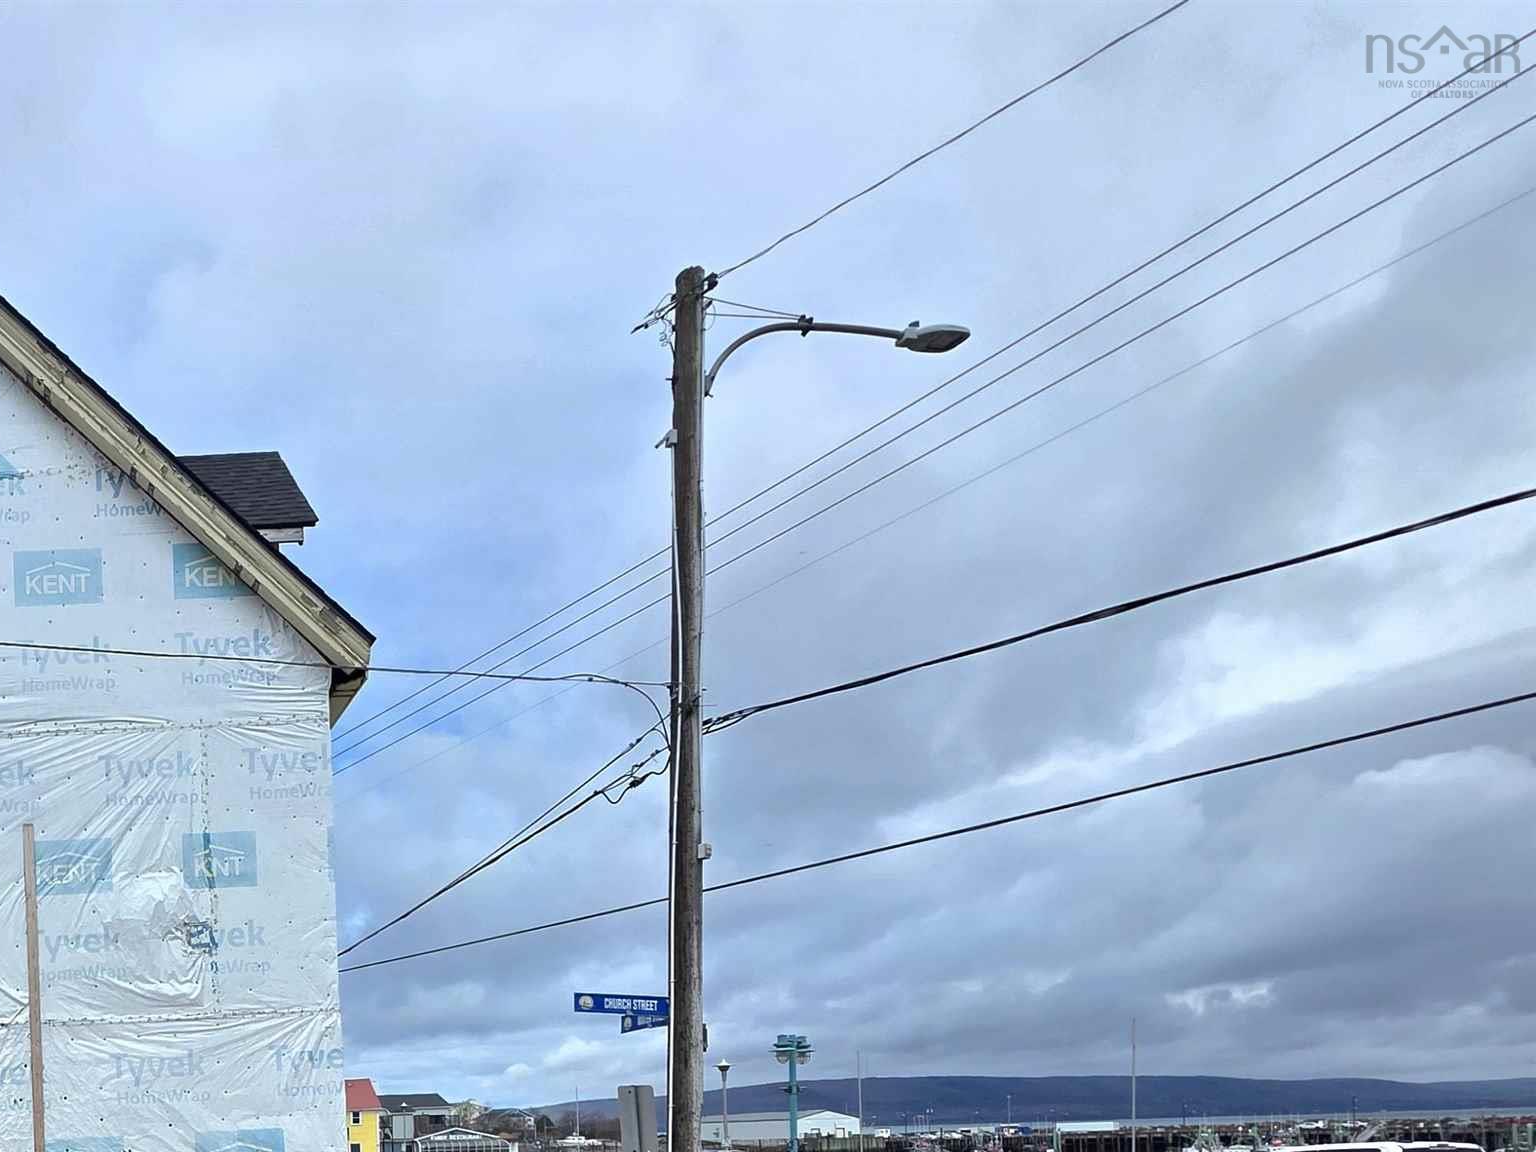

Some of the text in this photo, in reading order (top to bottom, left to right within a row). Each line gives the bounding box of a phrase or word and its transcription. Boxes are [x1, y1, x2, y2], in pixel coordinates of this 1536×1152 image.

[96, 502, 161, 518] HomeW
[25, 573, 91, 595] KENT
[185, 567, 236, 588] KEN
[16, 636, 113, 674] Tyvek
[174, 629, 272, 665] Tyvek
[22, 676, 116, 695] HomeWrap
[182, 669, 277, 687] HomeWrap
[96, 750, 194, 787] Tyvek
[604, 998, 657, 1011] CHURCH STREET
[113, 1050, 205, 1087] Tyvek
